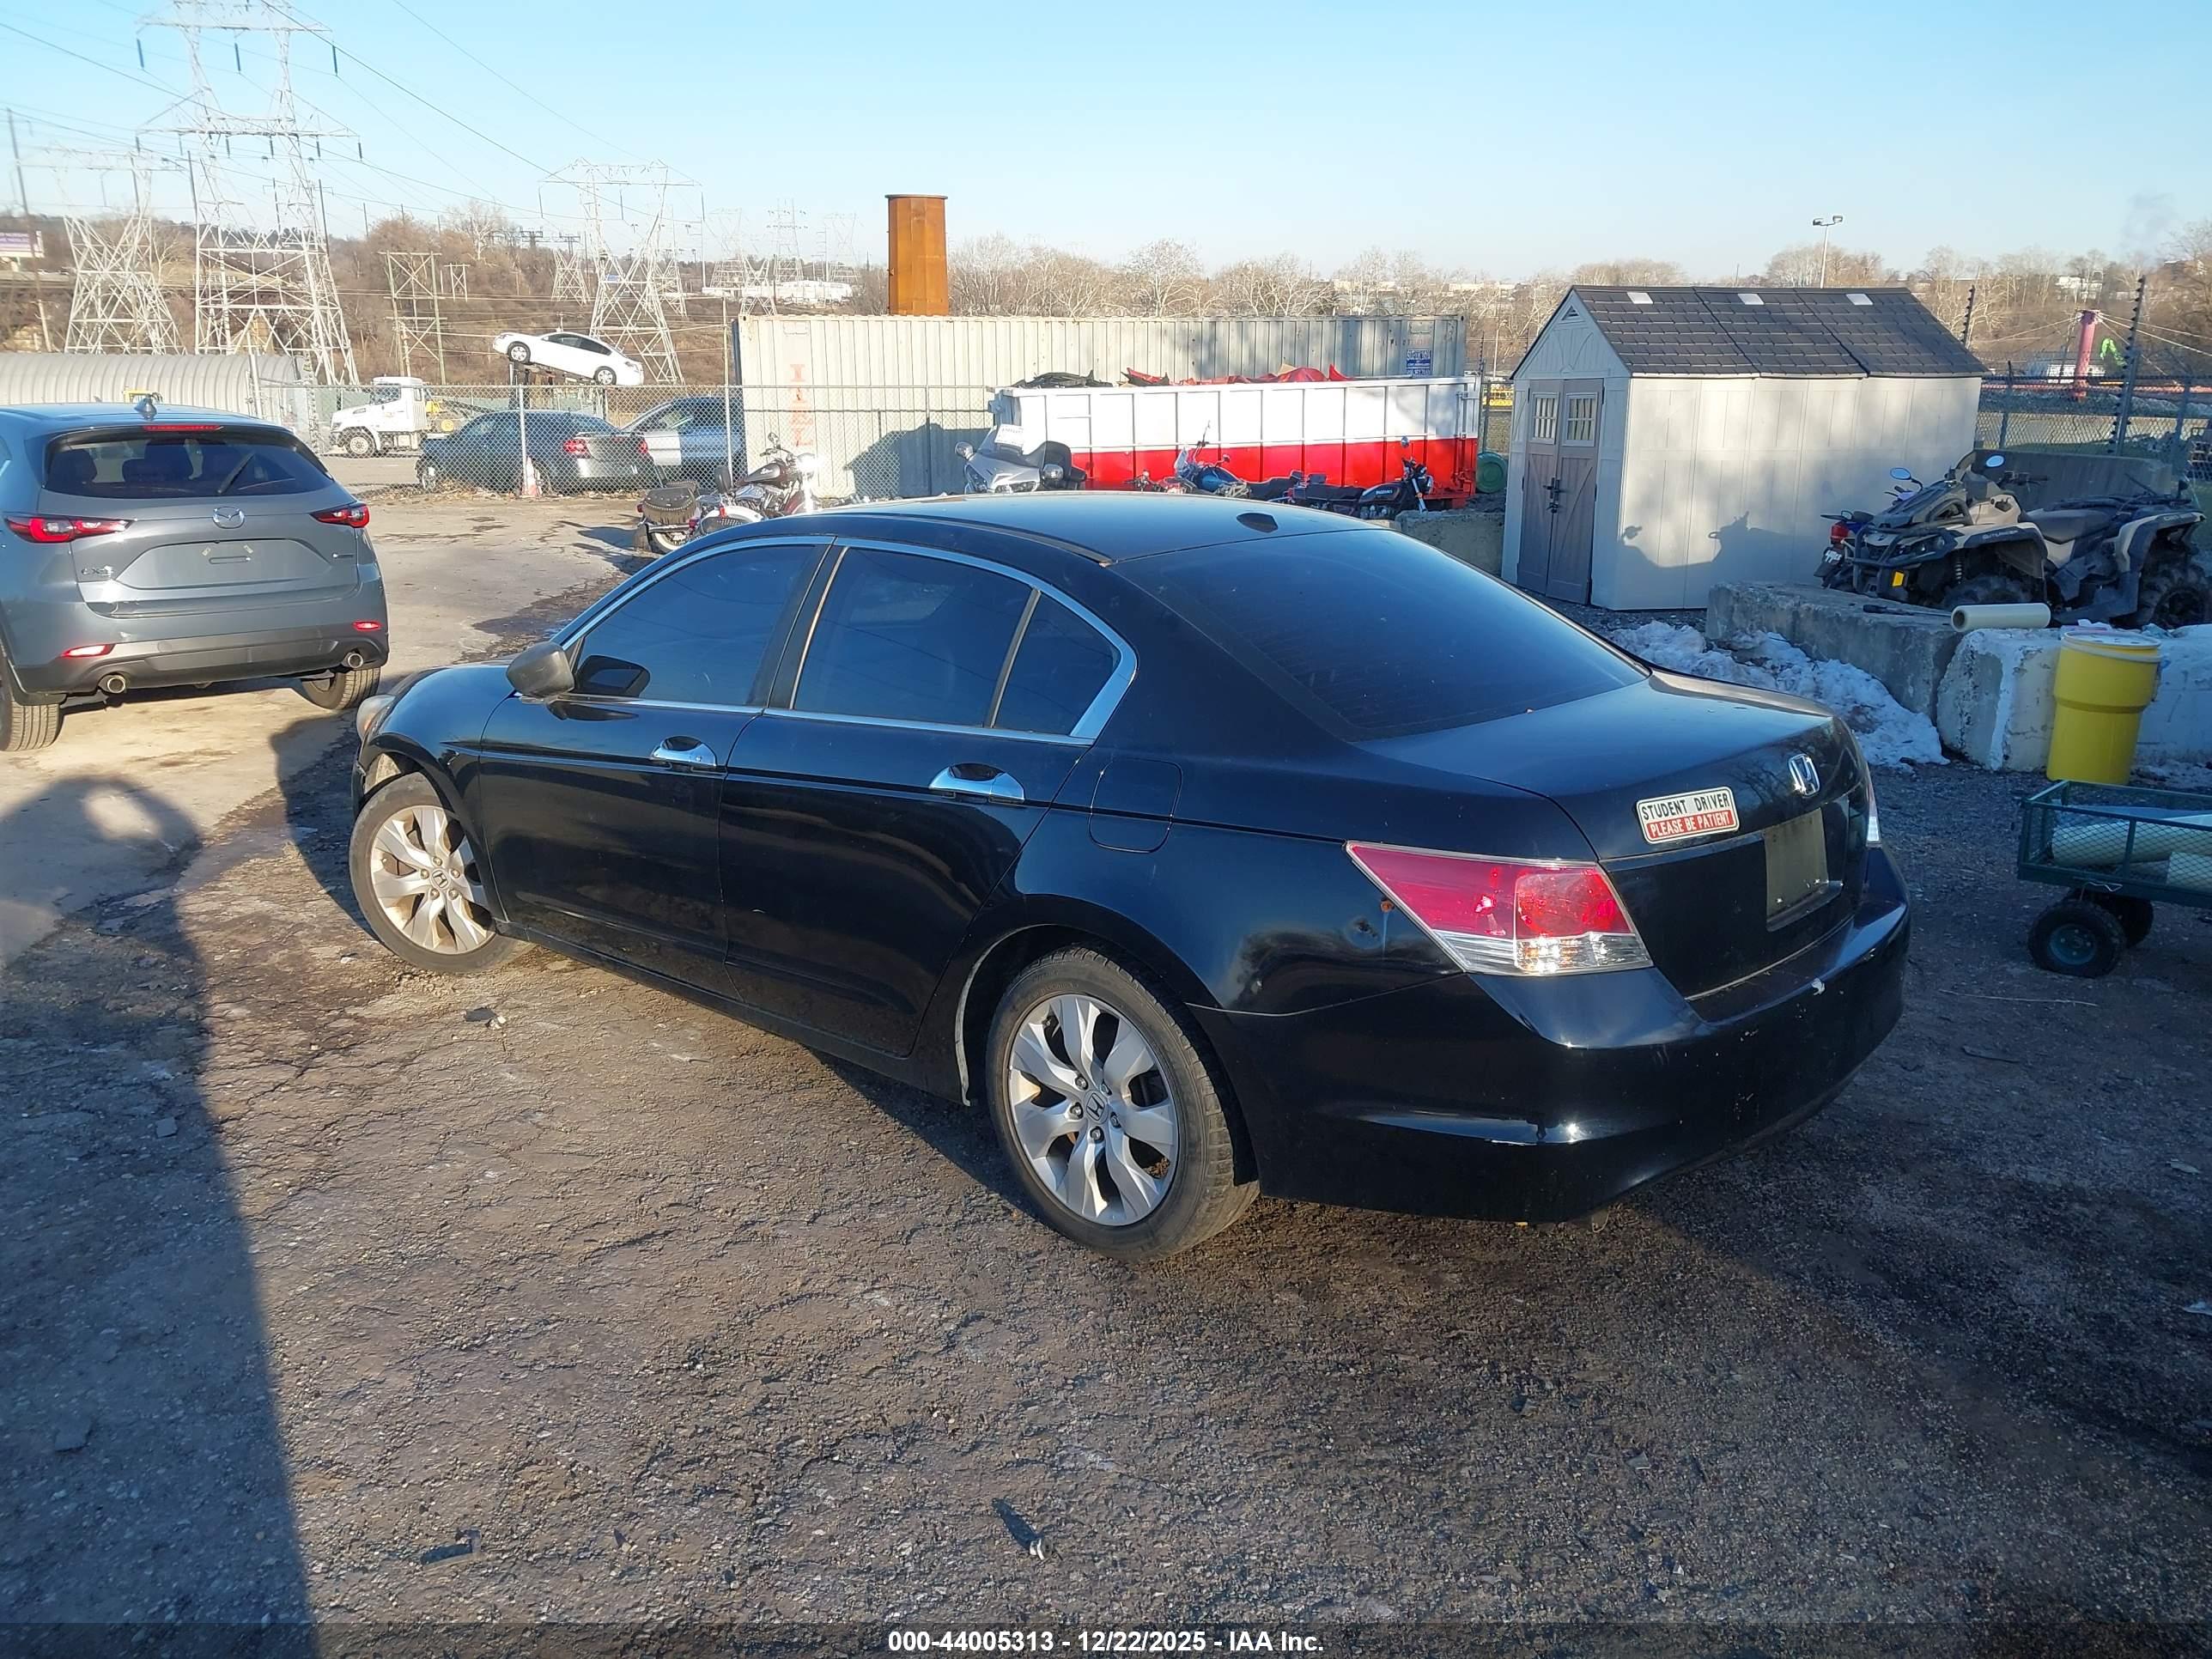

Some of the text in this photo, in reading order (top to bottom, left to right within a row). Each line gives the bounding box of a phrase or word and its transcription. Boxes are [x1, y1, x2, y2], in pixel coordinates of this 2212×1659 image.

[1641, 793, 1730, 821] STUDENT DRIVER
[1650, 811, 1731, 838] PLEASE BE PATIENT
